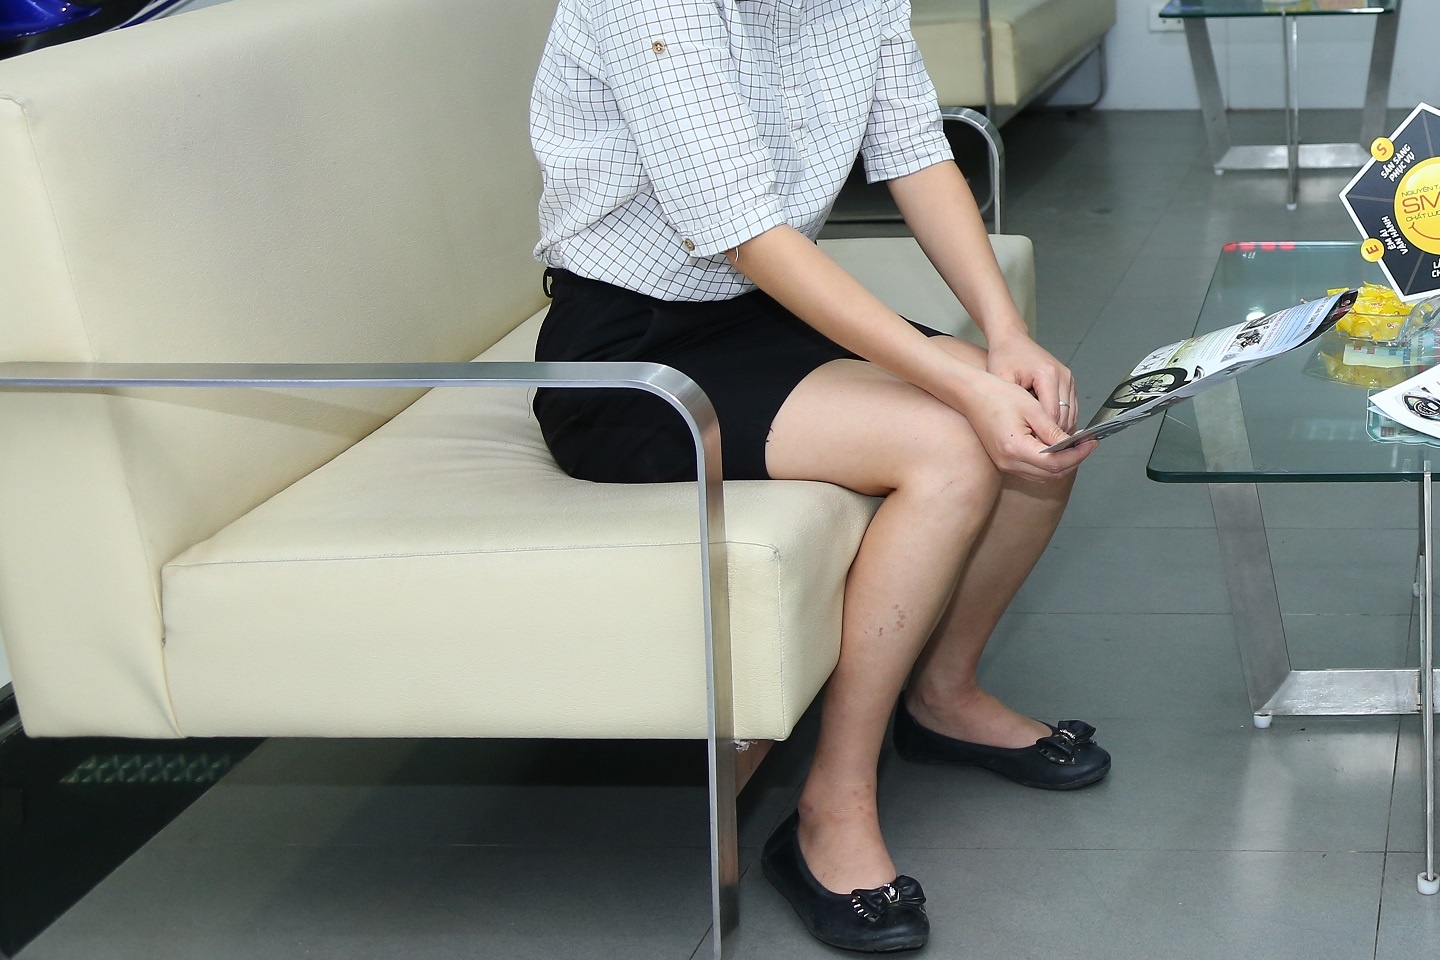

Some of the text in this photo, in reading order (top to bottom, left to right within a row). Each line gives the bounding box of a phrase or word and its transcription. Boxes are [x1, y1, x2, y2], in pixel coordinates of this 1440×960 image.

[1376, 143, 1387, 156] S
[1393, 143, 1411, 165] SÀNG
[1389, 152, 1416, 183] PHỤC VỤ
[1401, 185, 1433, 197] NGUYÊN
[1405, 211, 1427, 223] CHẤT
[1382, 215, 1409, 255] VẬN HÀNH
[1366, 244, 1379, 254] E
